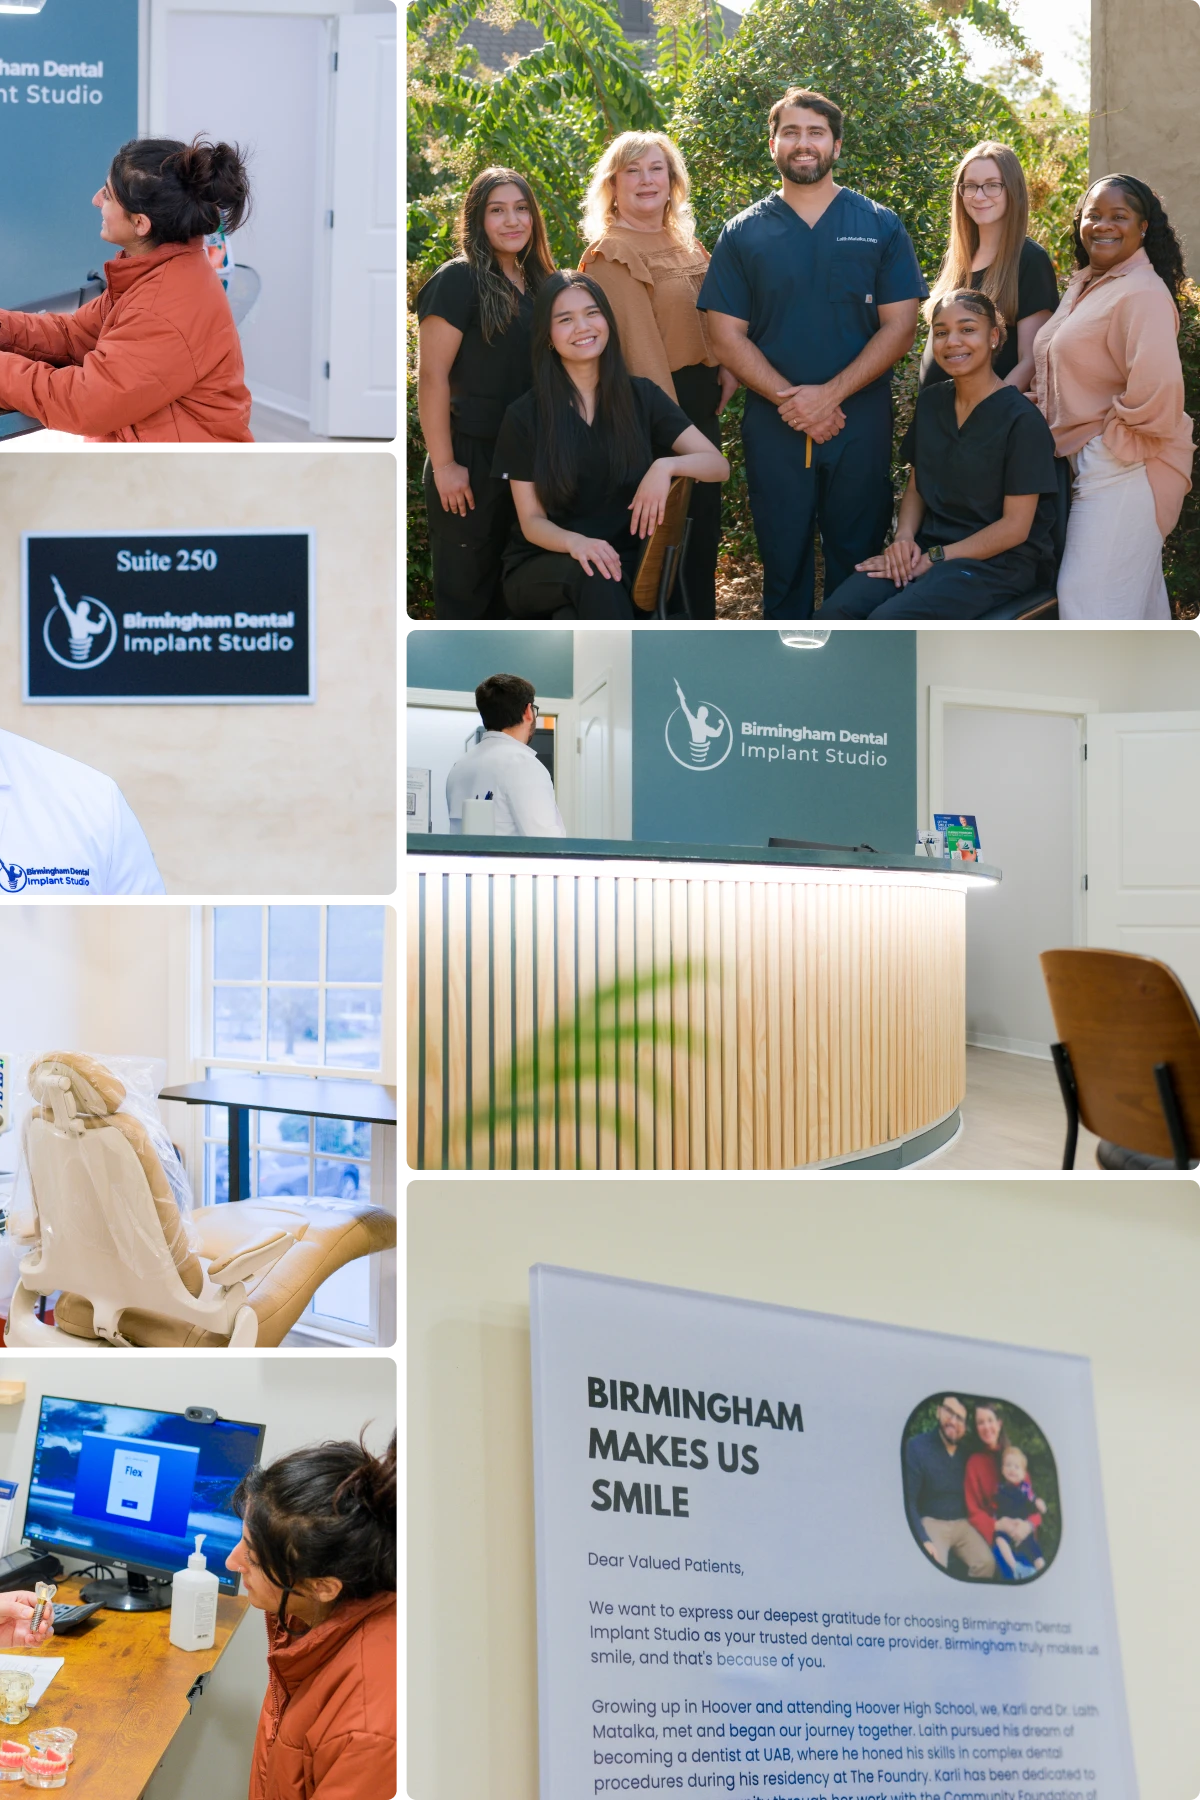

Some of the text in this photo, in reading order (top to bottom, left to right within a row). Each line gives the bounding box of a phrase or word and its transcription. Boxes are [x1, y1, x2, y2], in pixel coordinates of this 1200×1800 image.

[43, 60, 104, 78] Dental
[27, 84, 103, 104] Studio
[116, 549, 218, 572] Suite 250
[123, 611, 295, 631] Birmingham Dental
[124, 632, 294, 655] Implant Studio
[741, 722, 888, 745] Birmingham Dental
[741, 742, 887, 766] Implant Studio
[26, 867, 89, 876] Birmingham Dental
[28, 877, 89, 886] Implant Studio
[588, 1376, 804, 1432] BIRMINGHAM
[589, 1427, 759, 1475] MAKES US
[125, 1466, 143, 1477] Flex
[590, 1479, 690, 1518] SMILE
[588, 1553, 744, 1576] Dear Valued Patients,
[589, 1601, 1072, 1634] We want to express our deepest gratitude for choosing Birmingham Dental
[591, 1625, 1099, 1656] Implant Studio as your trusted dental care provider. Birmingham truly makes us
[591, 1650, 826, 1671] smile, and that's because of you.
[592, 1699, 1099, 1718] Growing up in Hoover and attending Hoover High School, we, Karli and Dr. Laith
[593, 1723, 1075, 1741] Matalka, met and began our journey together. Laith pursued his dream of
[593, 1746, 1063, 1767] becoming a dentist at UAB, where he honed his skills in complex dental
[594, 1767, 1096, 1795] procedures during his residency at The Foundry. Karli has been dedicated to
